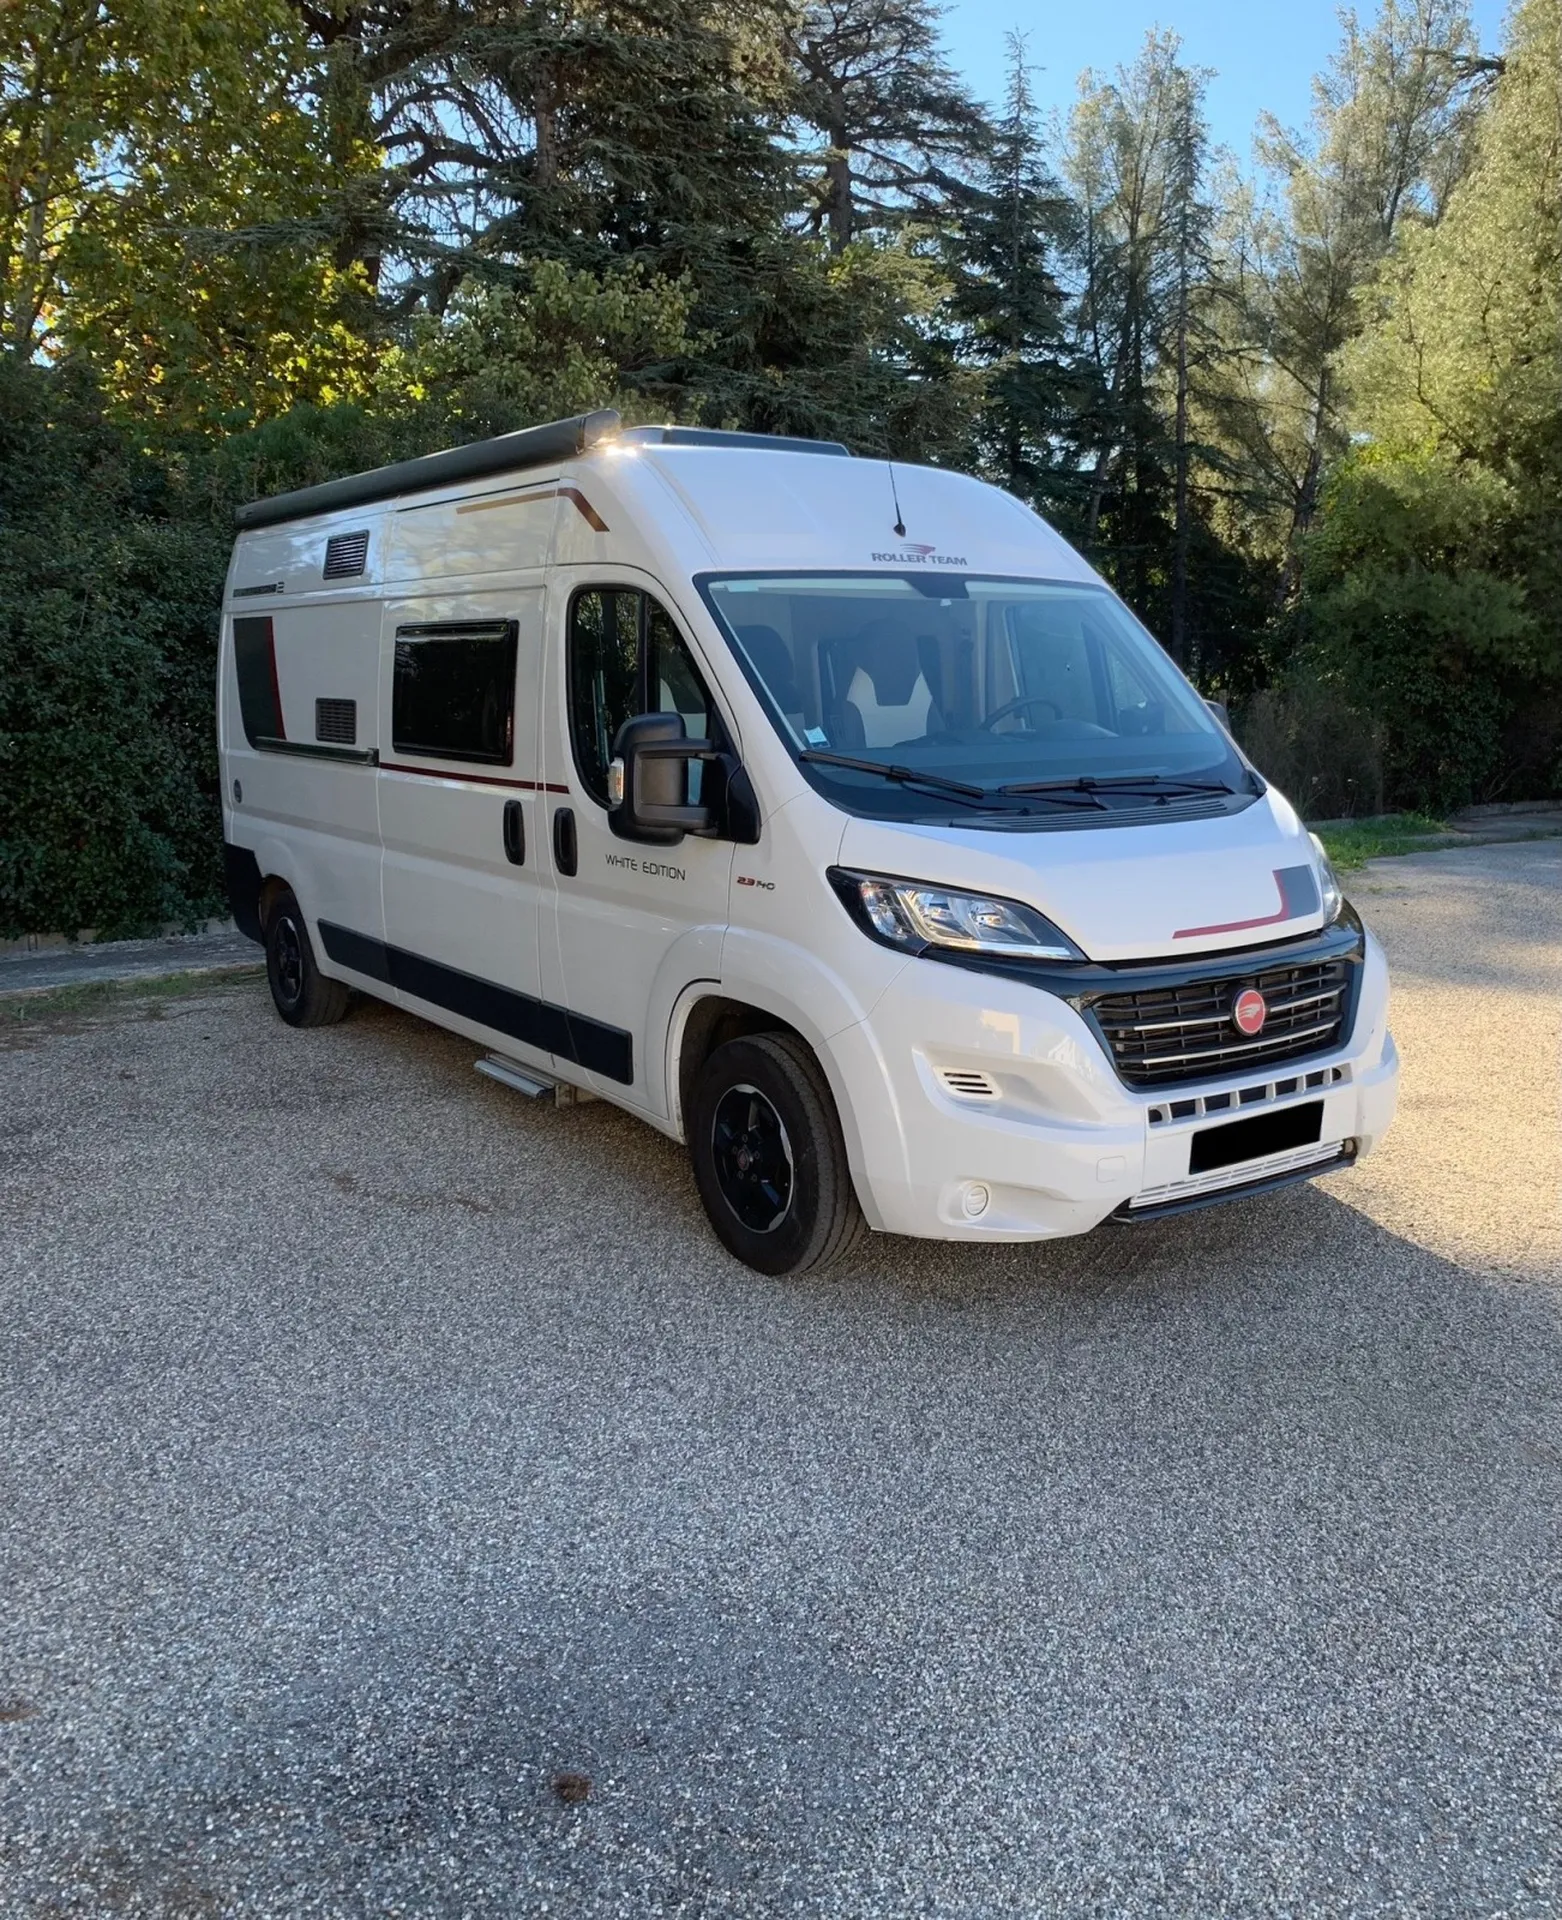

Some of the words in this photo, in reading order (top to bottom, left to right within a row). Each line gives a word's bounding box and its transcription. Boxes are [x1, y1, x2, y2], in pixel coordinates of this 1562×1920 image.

[871, 552, 926, 564] ROLLER
[929, 556, 968, 566] TEAM
[605, 854, 638, 871] WHITE
[642, 861, 686, 881] EDITION
[756, 880, 775, 890] 140
